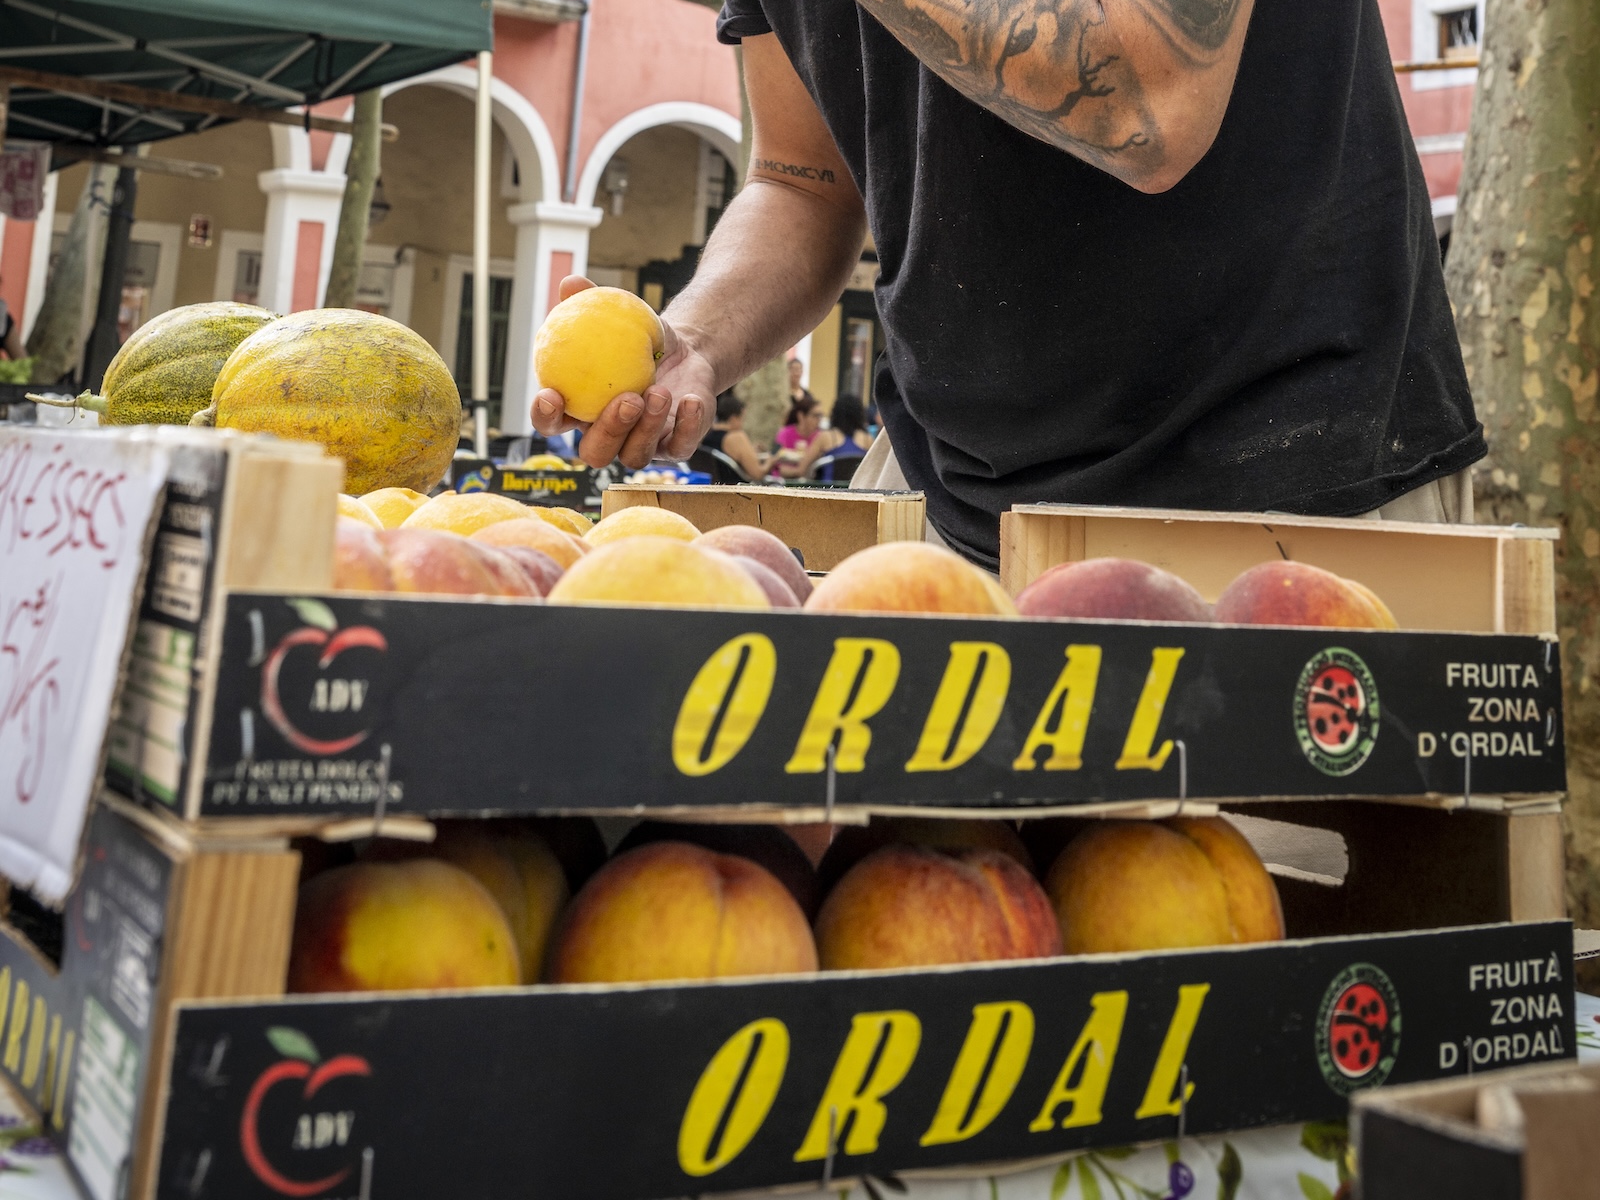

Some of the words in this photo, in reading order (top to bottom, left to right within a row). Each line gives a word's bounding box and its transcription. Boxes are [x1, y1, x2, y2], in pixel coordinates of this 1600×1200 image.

[1446, 663, 1539, 688] FRUITA
[309, 679, 369, 712] ADV
[672, 633, 1185, 776] ORDAL
[1468, 697, 1541, 722] ZONA
[1469, 958, 1560, 991] FRUITA
[1491, 993, 1563, 1025] ZONA
[677, 983, 1211, 1176] ORDAL
[292, 1110, 355, 1150] ADV
